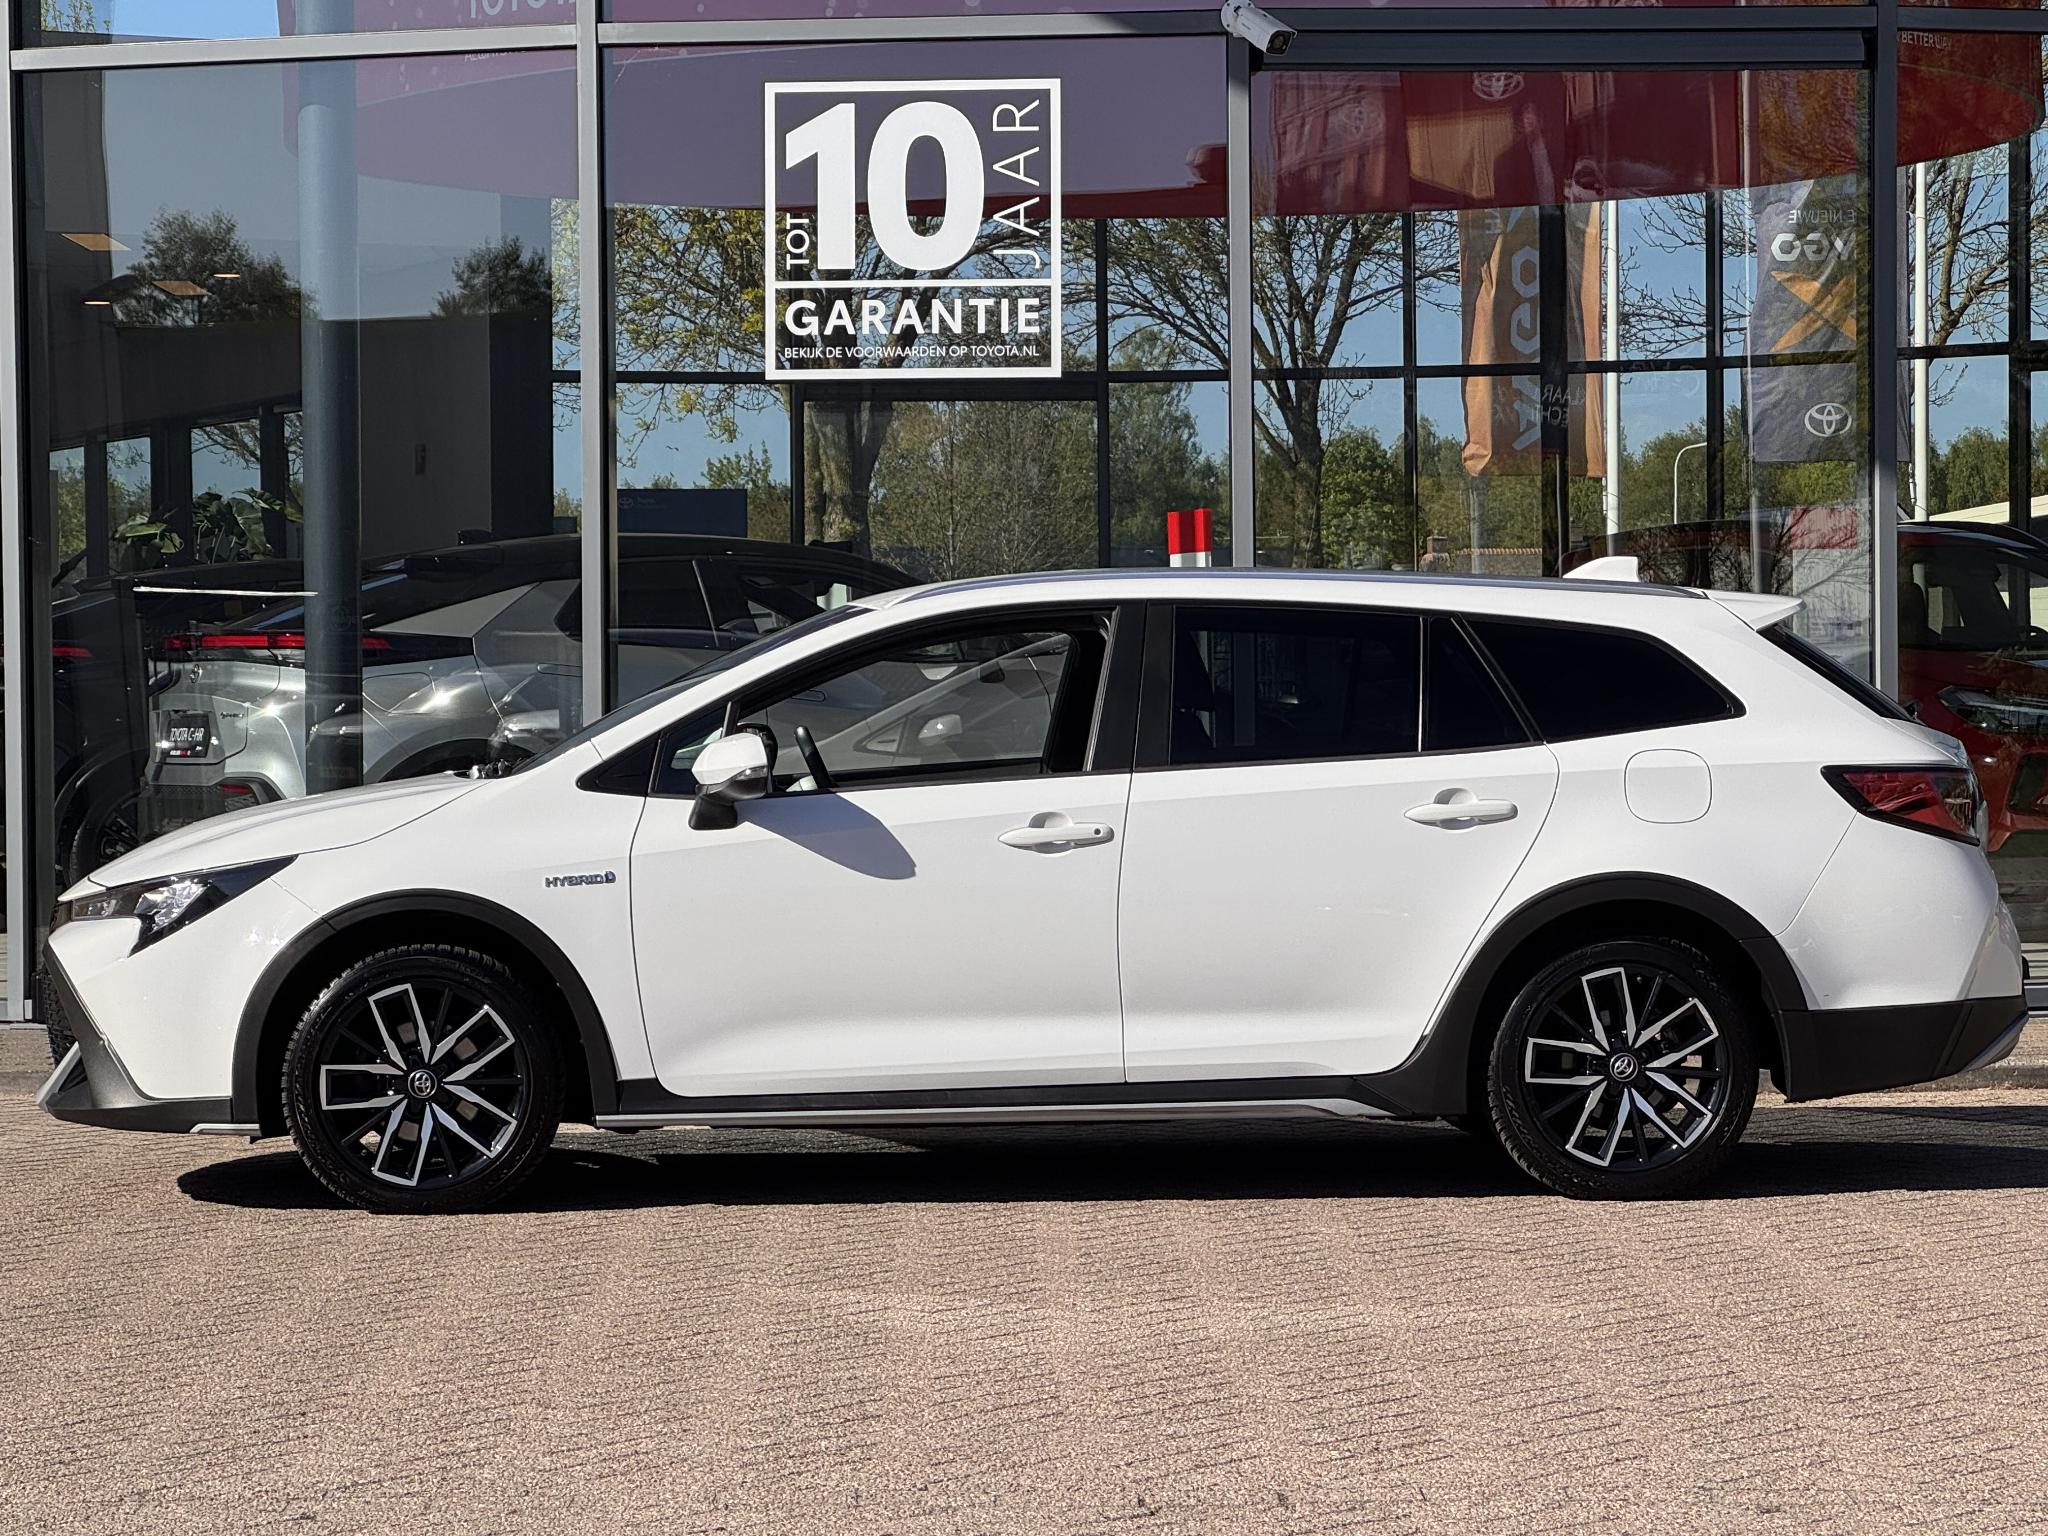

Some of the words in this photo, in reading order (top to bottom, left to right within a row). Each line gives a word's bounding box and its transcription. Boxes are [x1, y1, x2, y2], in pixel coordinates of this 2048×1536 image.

[1902, 31, 1935, 47] BETTER
[785, 101, 985, 271] 10
[992, 98, 1040, 269] JAAR
[786, 213, 810, 270] TOT
[785, 297, 1040, 336] GARANTIE
[784, 346, 823, 359] BEKIJK
[826, 346, 842, 358] DE
[845, 345, 946, 358] VOORWAARDEN
[949, 345, 968, 357] OP
[970, 344, 1040, 357] TOYOTA.NL
[545, 873, 604, 888] HYBRID
